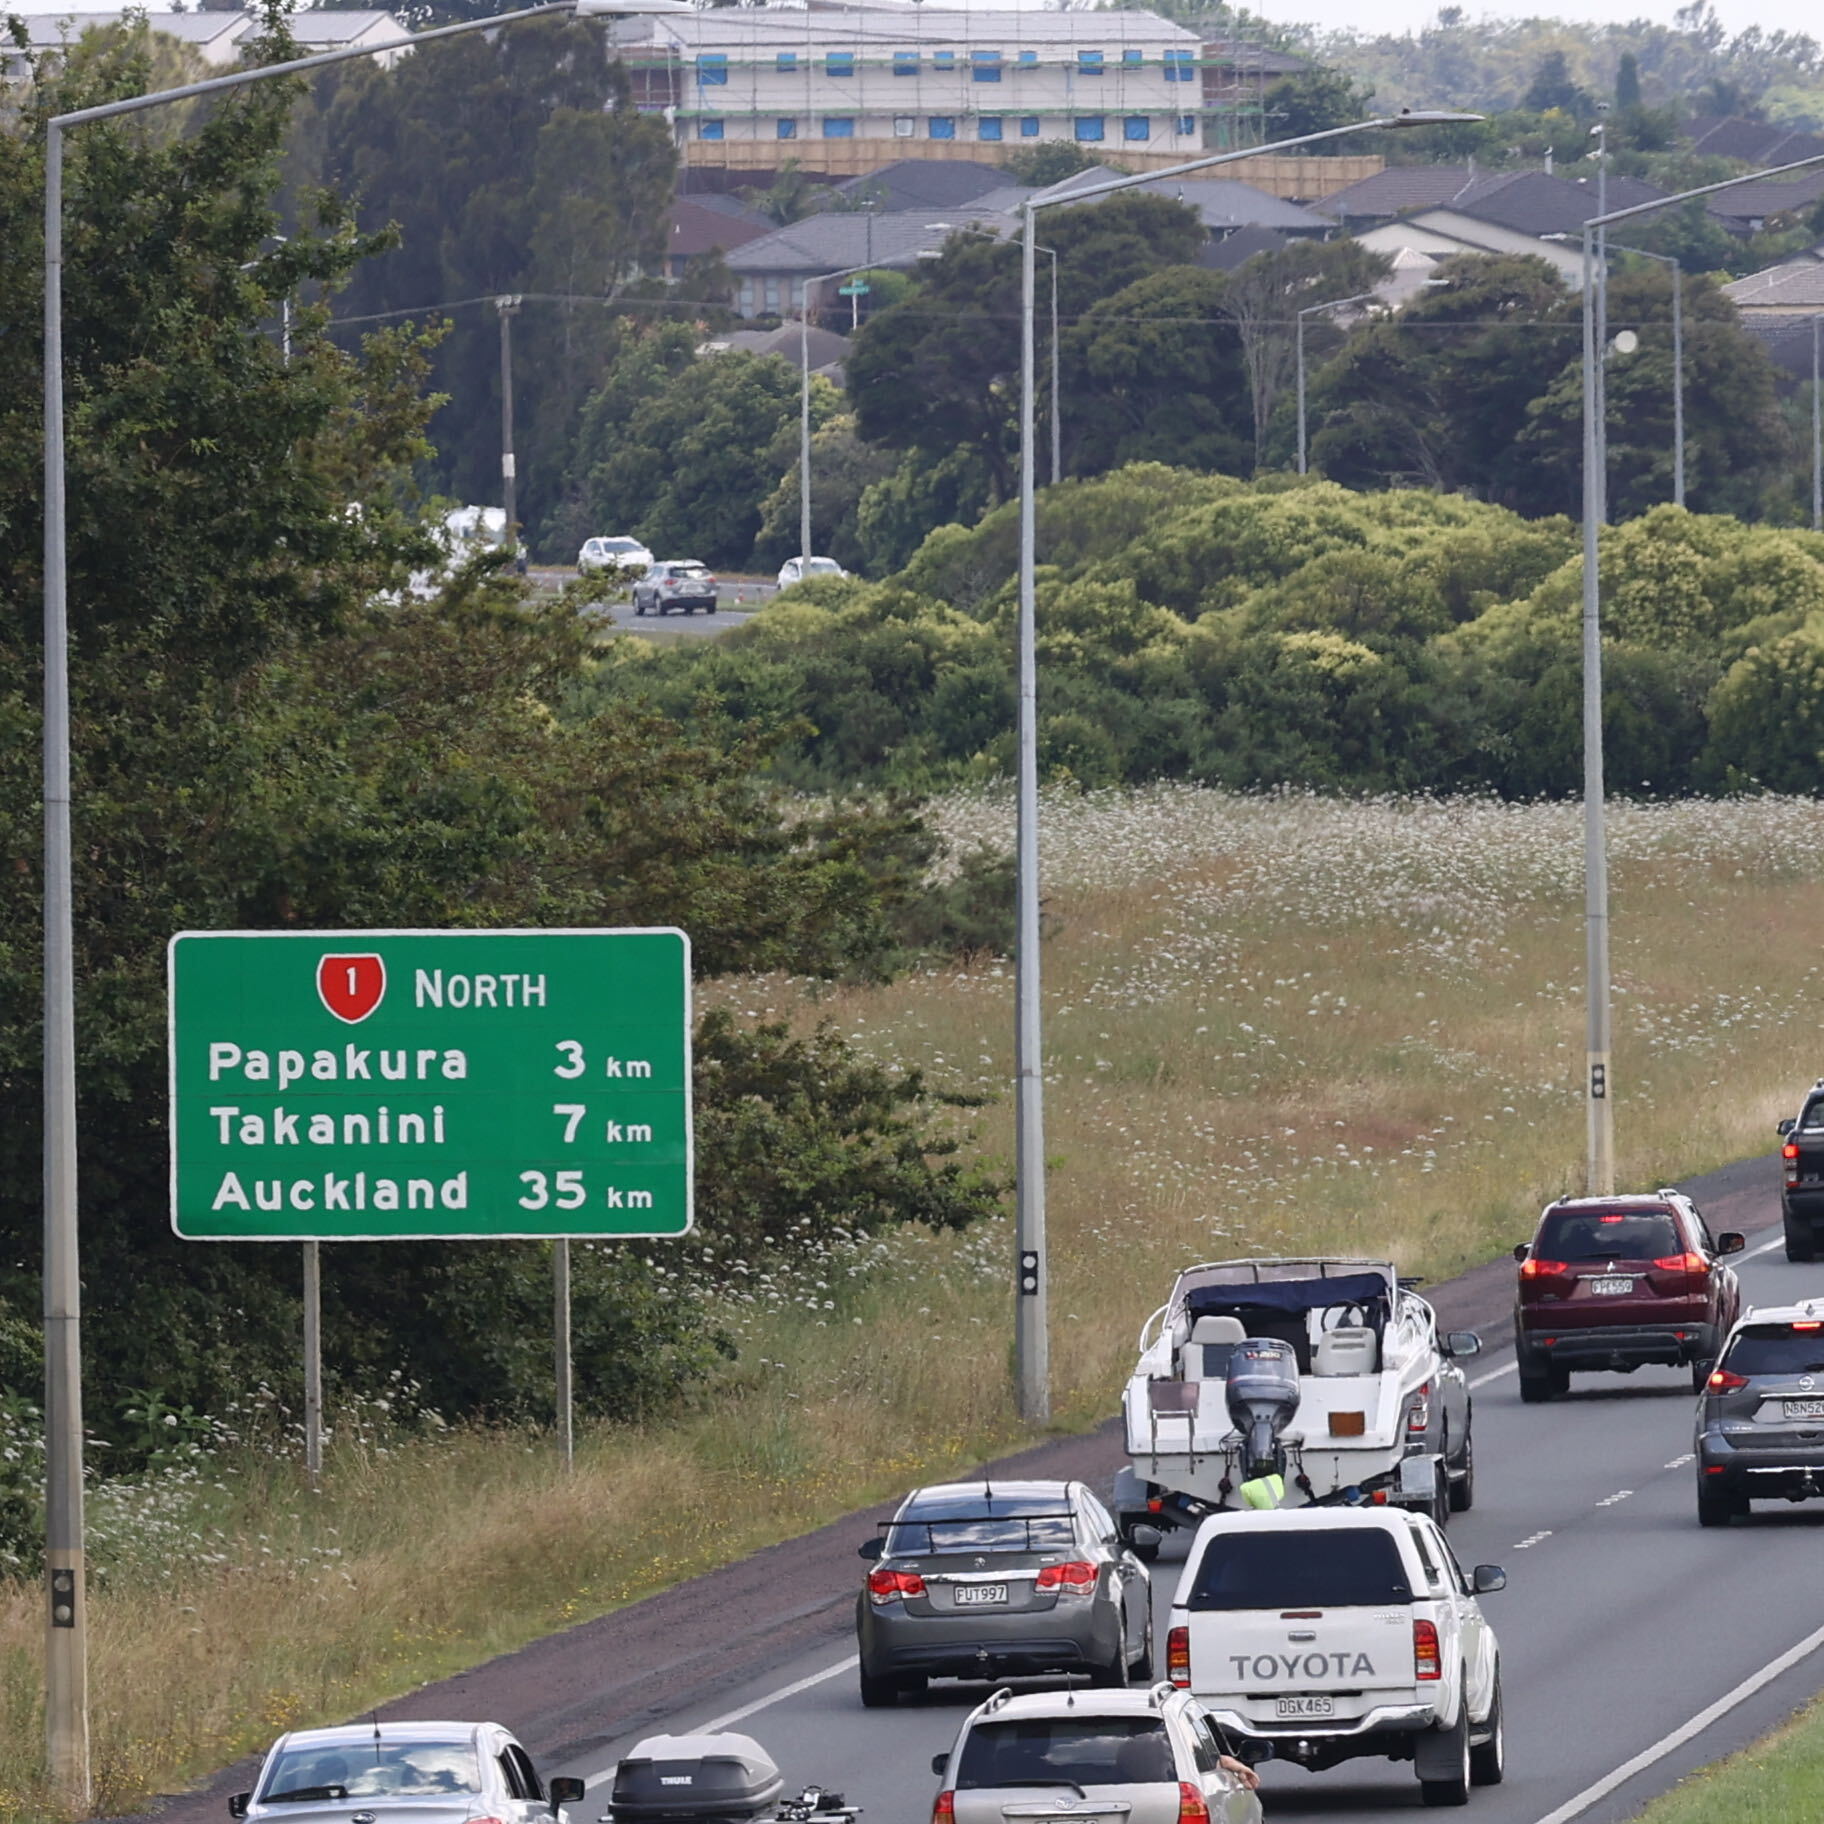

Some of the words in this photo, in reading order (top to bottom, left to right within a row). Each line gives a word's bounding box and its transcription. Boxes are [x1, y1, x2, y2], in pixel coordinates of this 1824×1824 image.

[347, 967, 357, 995] 1
[416, 970, 545, 1008] NORTH
[210, 1043, 467, 1090] Papakura
[554, 1040, 585, 1079] 3
[607, 1057, 651, 1078] km
[210, 1106, 444, 1145] Takanini
[554, 1104, 586, 1143] 7
[608, 1121, 651, 1142] km
[212, 1171, 467, 1210] Auckland
[518, 1170, 586, 1210] 35
[608, 1187, 652, 1208] km
[957, 1586, 1005, 1602] FUT997
[1229, 1652, 1376, 1681] TOYOTA
